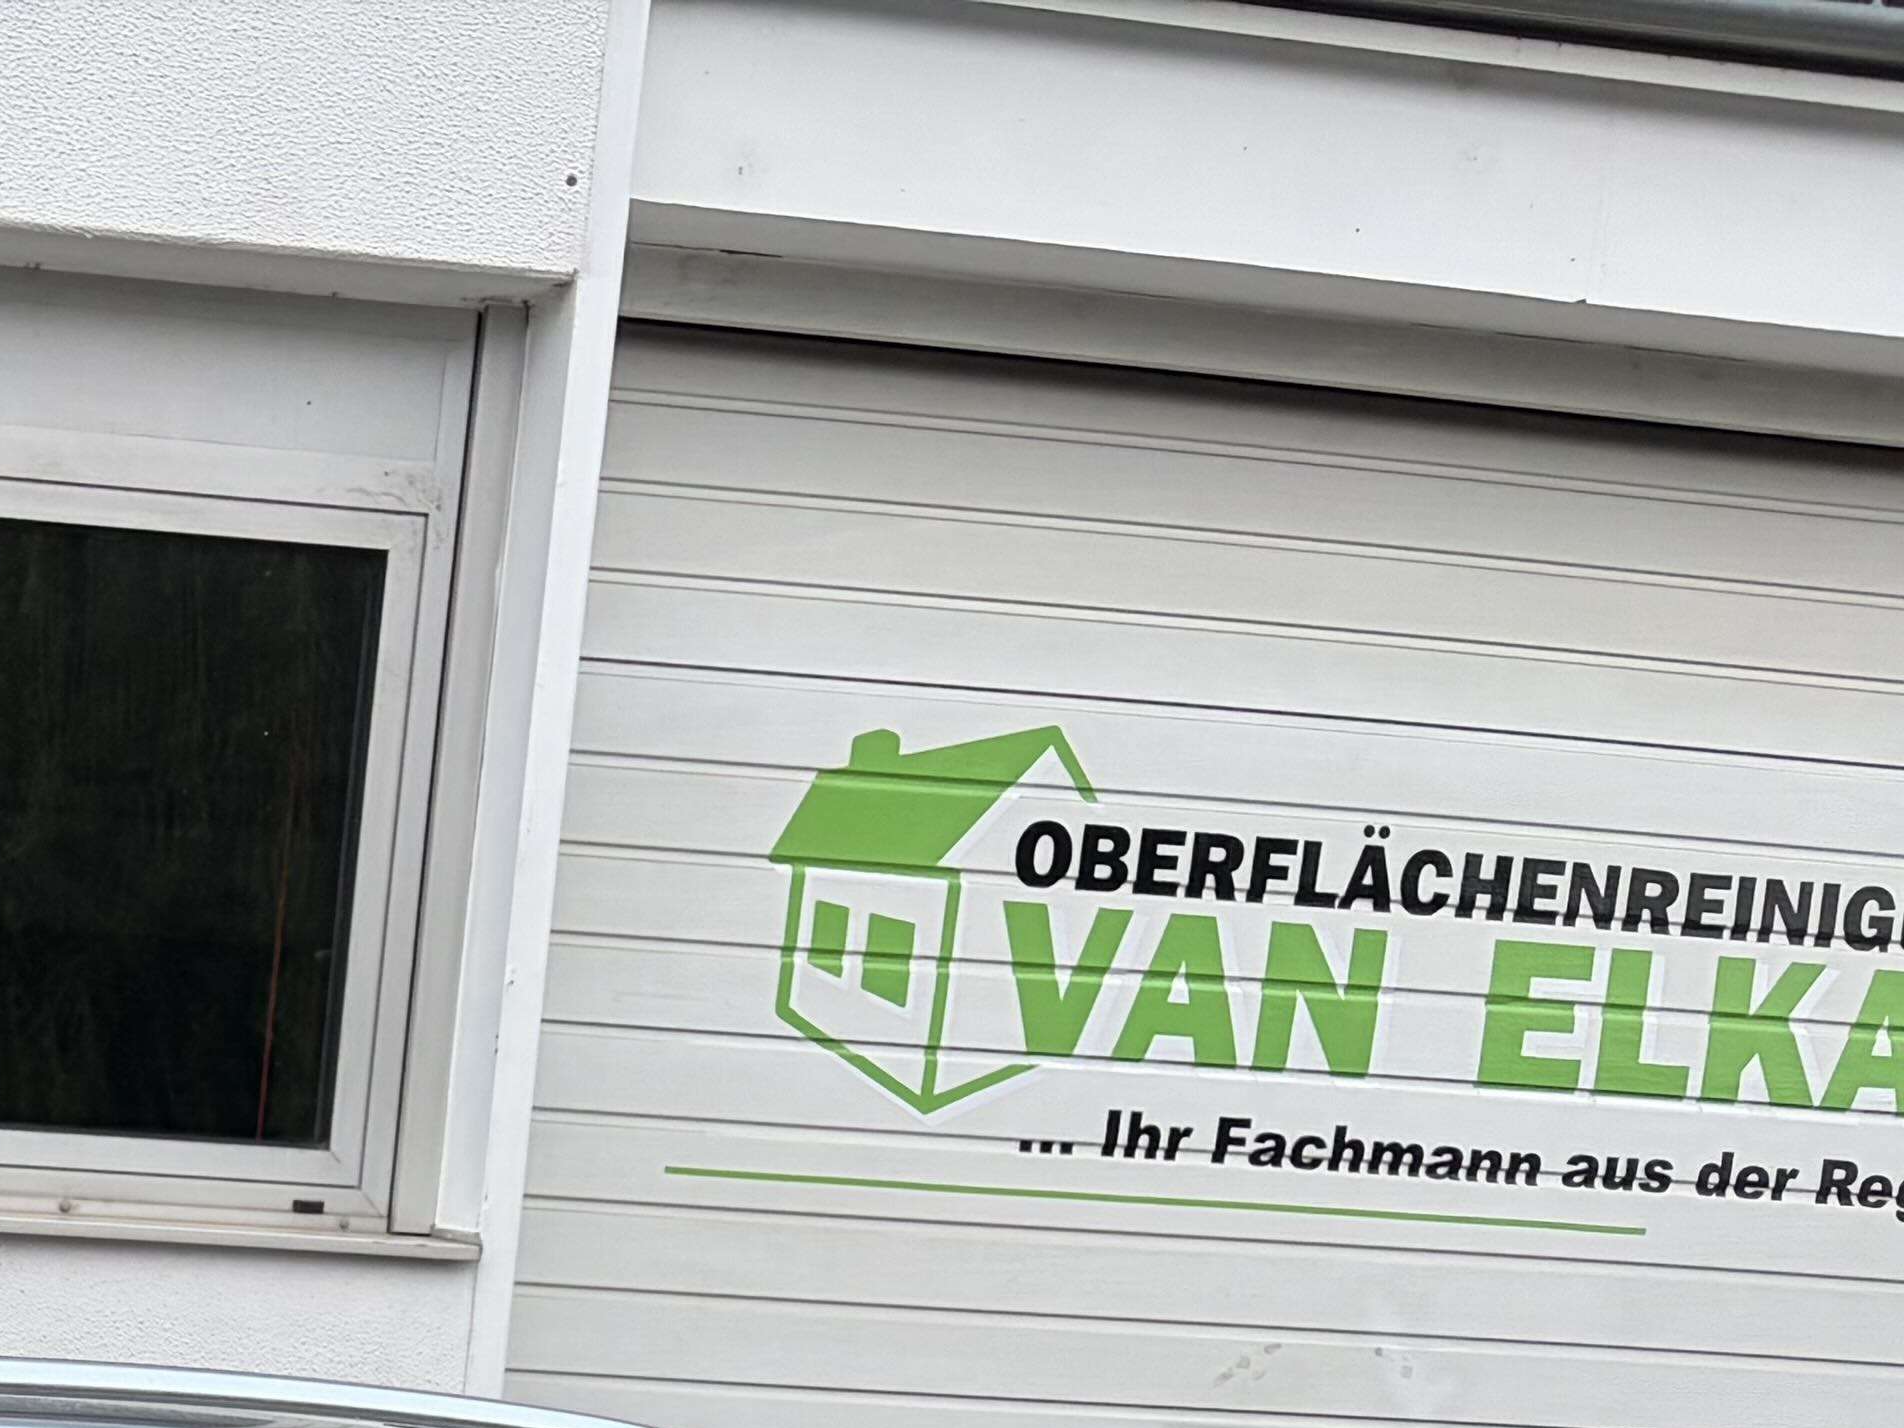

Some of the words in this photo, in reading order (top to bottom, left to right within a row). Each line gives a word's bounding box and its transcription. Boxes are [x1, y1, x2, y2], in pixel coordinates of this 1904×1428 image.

[1015, 820, 1904, 954] OBERFLÄCHENREINIG
[1004, 900, 1388, 1078] VAN
[1101, 1109, 1193, 1161] Ihr
[1211, 1116, 1542, 1186] Fachmann
[1561, 1153, 1674, 1193] aus
[1695, 1152, 1799, 1201] der
